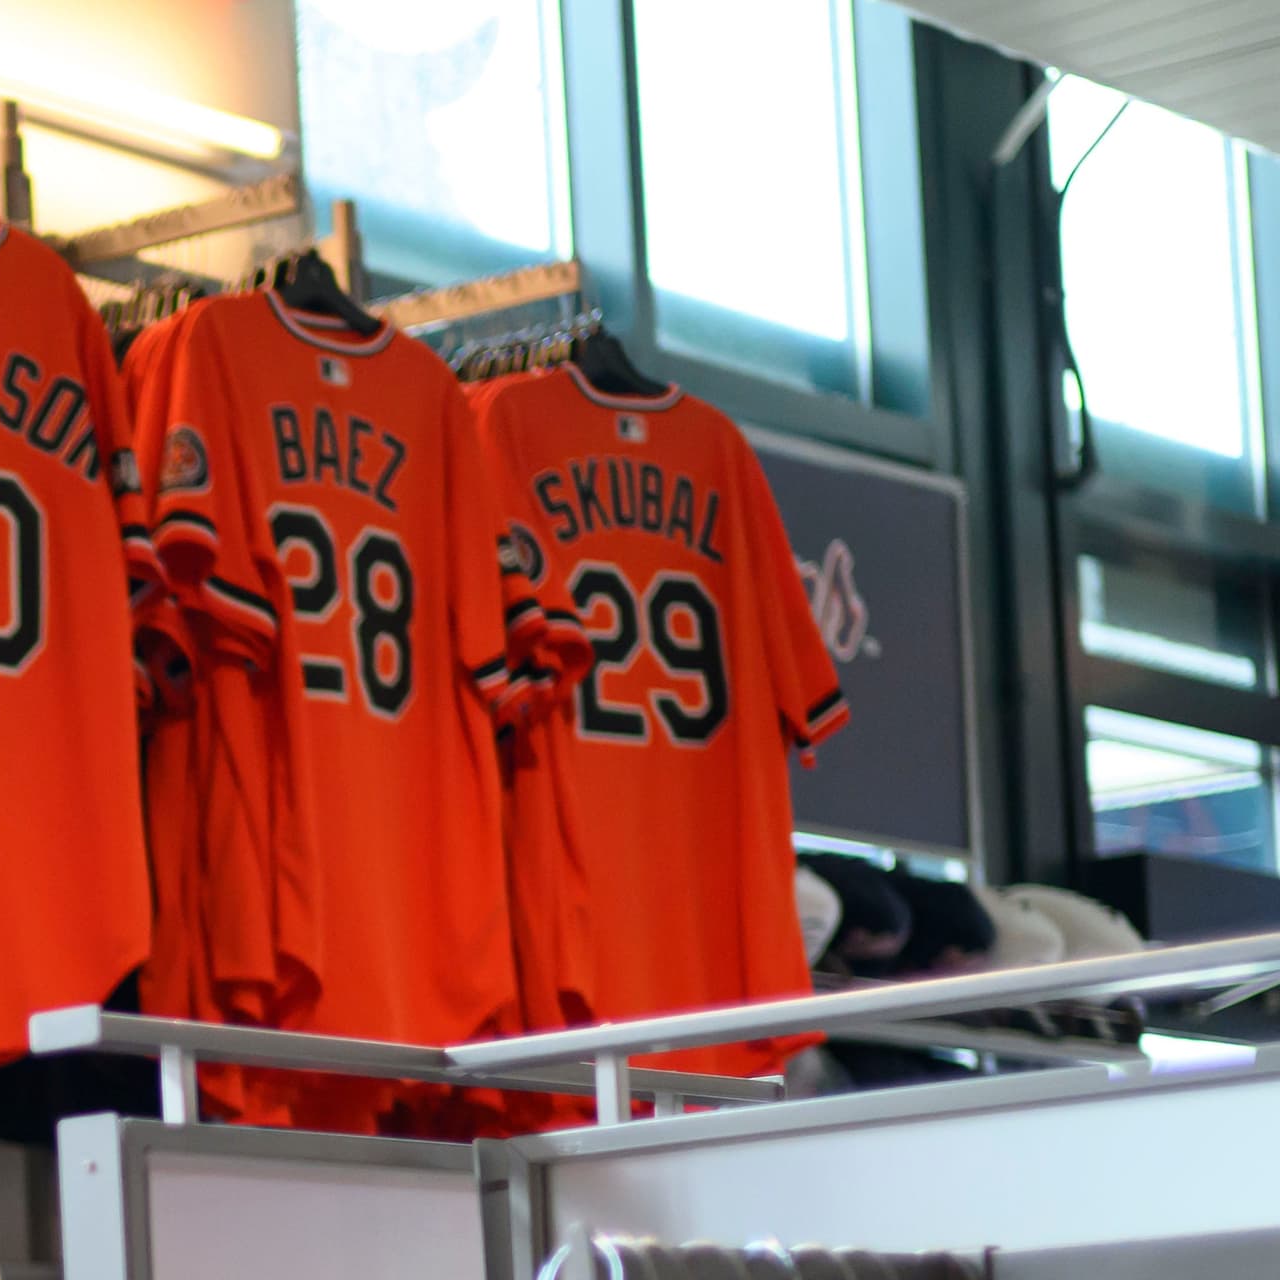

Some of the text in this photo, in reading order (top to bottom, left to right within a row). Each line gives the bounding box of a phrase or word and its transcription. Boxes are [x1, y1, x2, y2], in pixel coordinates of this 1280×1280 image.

[271, 404, 407, 512] BAEZ
[535, 455, 726, 566] SKUBAL
[266, 502, 415, 722] 28
[564, 559, 731, 748] 29
